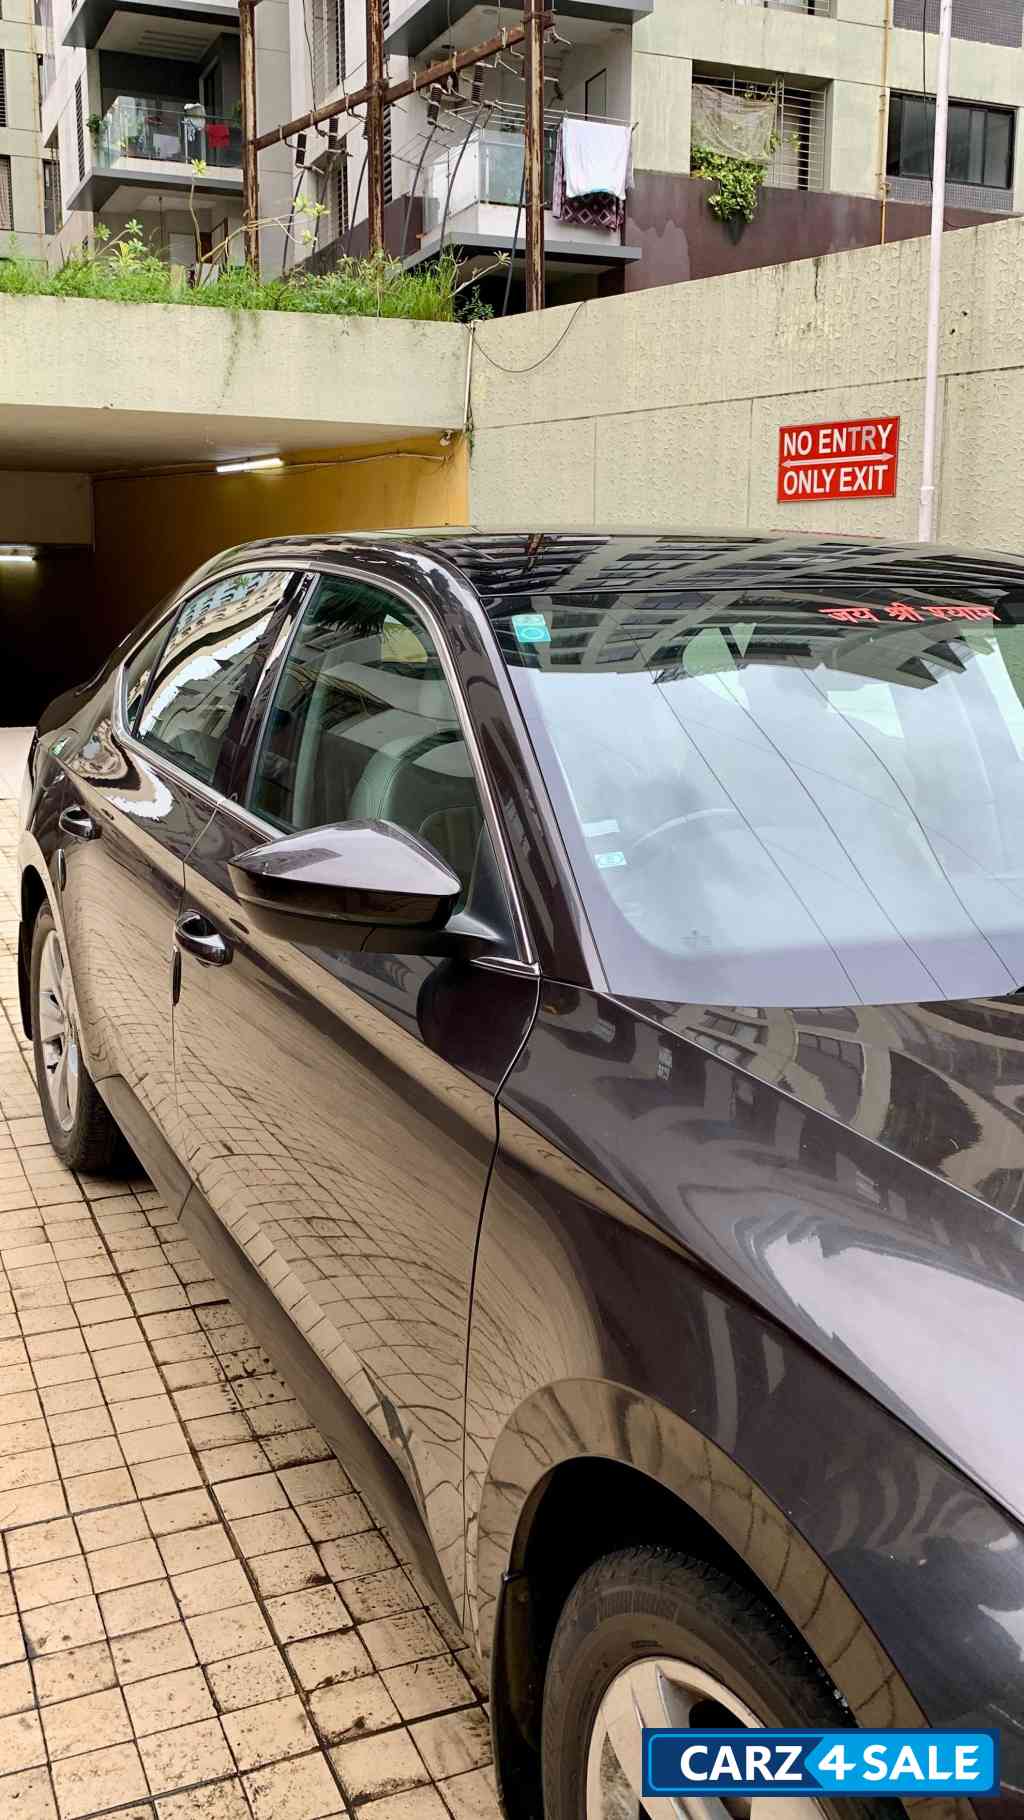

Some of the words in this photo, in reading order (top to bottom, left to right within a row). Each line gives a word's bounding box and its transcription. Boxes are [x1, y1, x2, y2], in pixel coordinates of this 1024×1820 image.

[783, 431, 812, 456] NO
[818, 424, 893, 454] ENTRY
[783, 468, 836, 495] ONLY
[840, 464, 889, 492] EXIT
[818, 608, 880, 623] जय
[884, 602, 925, 622] श्री
